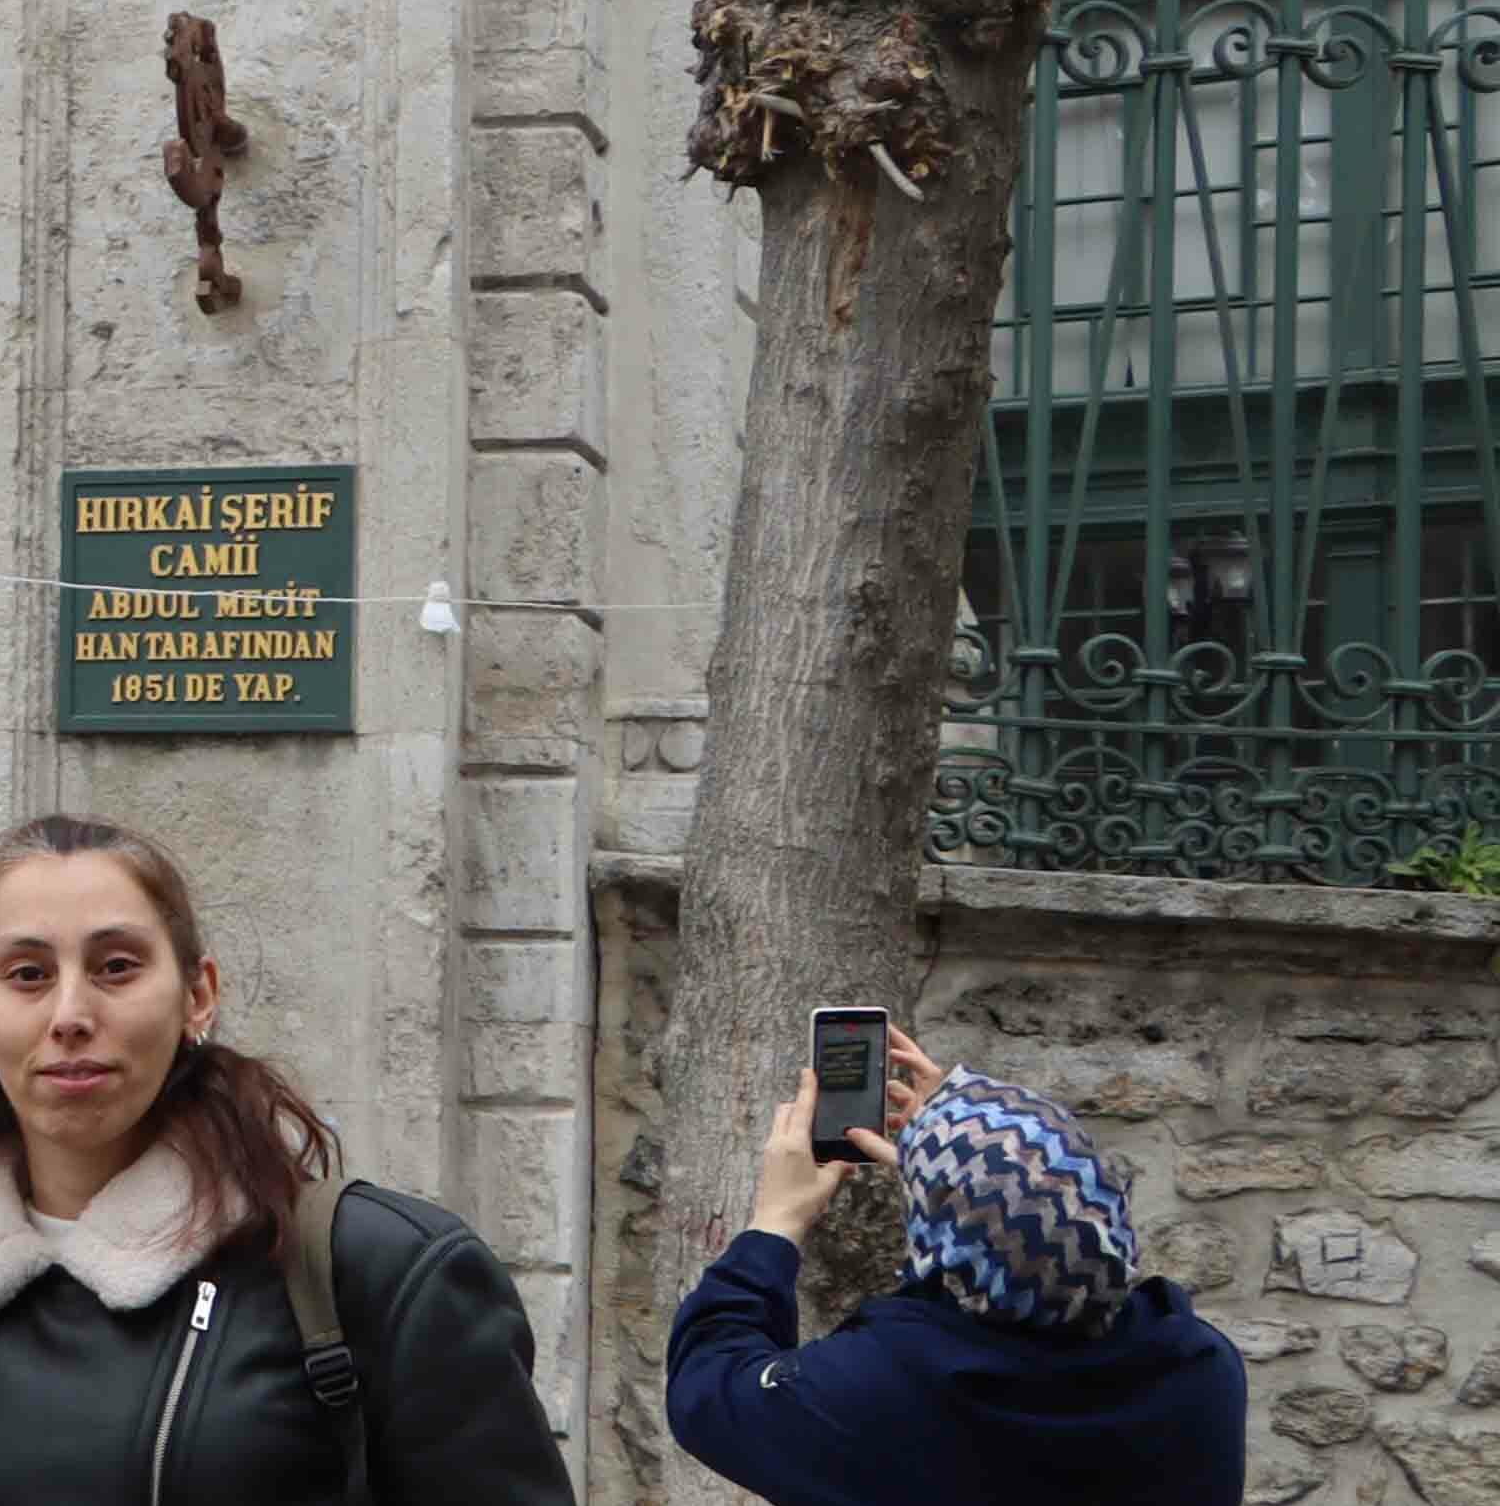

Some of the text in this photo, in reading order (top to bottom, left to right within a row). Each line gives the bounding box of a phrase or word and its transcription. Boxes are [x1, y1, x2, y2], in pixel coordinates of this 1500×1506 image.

[220, 483, 335, 534] ŞERİF
[150, 534, 260, 577] CAMİİ
[88, 580, 321, 620] ABDUL MECİT
[76, 630, 337, 661] HAN TARAFINDAN
[111, 674, 301, 703] 1851 DE YAP.
